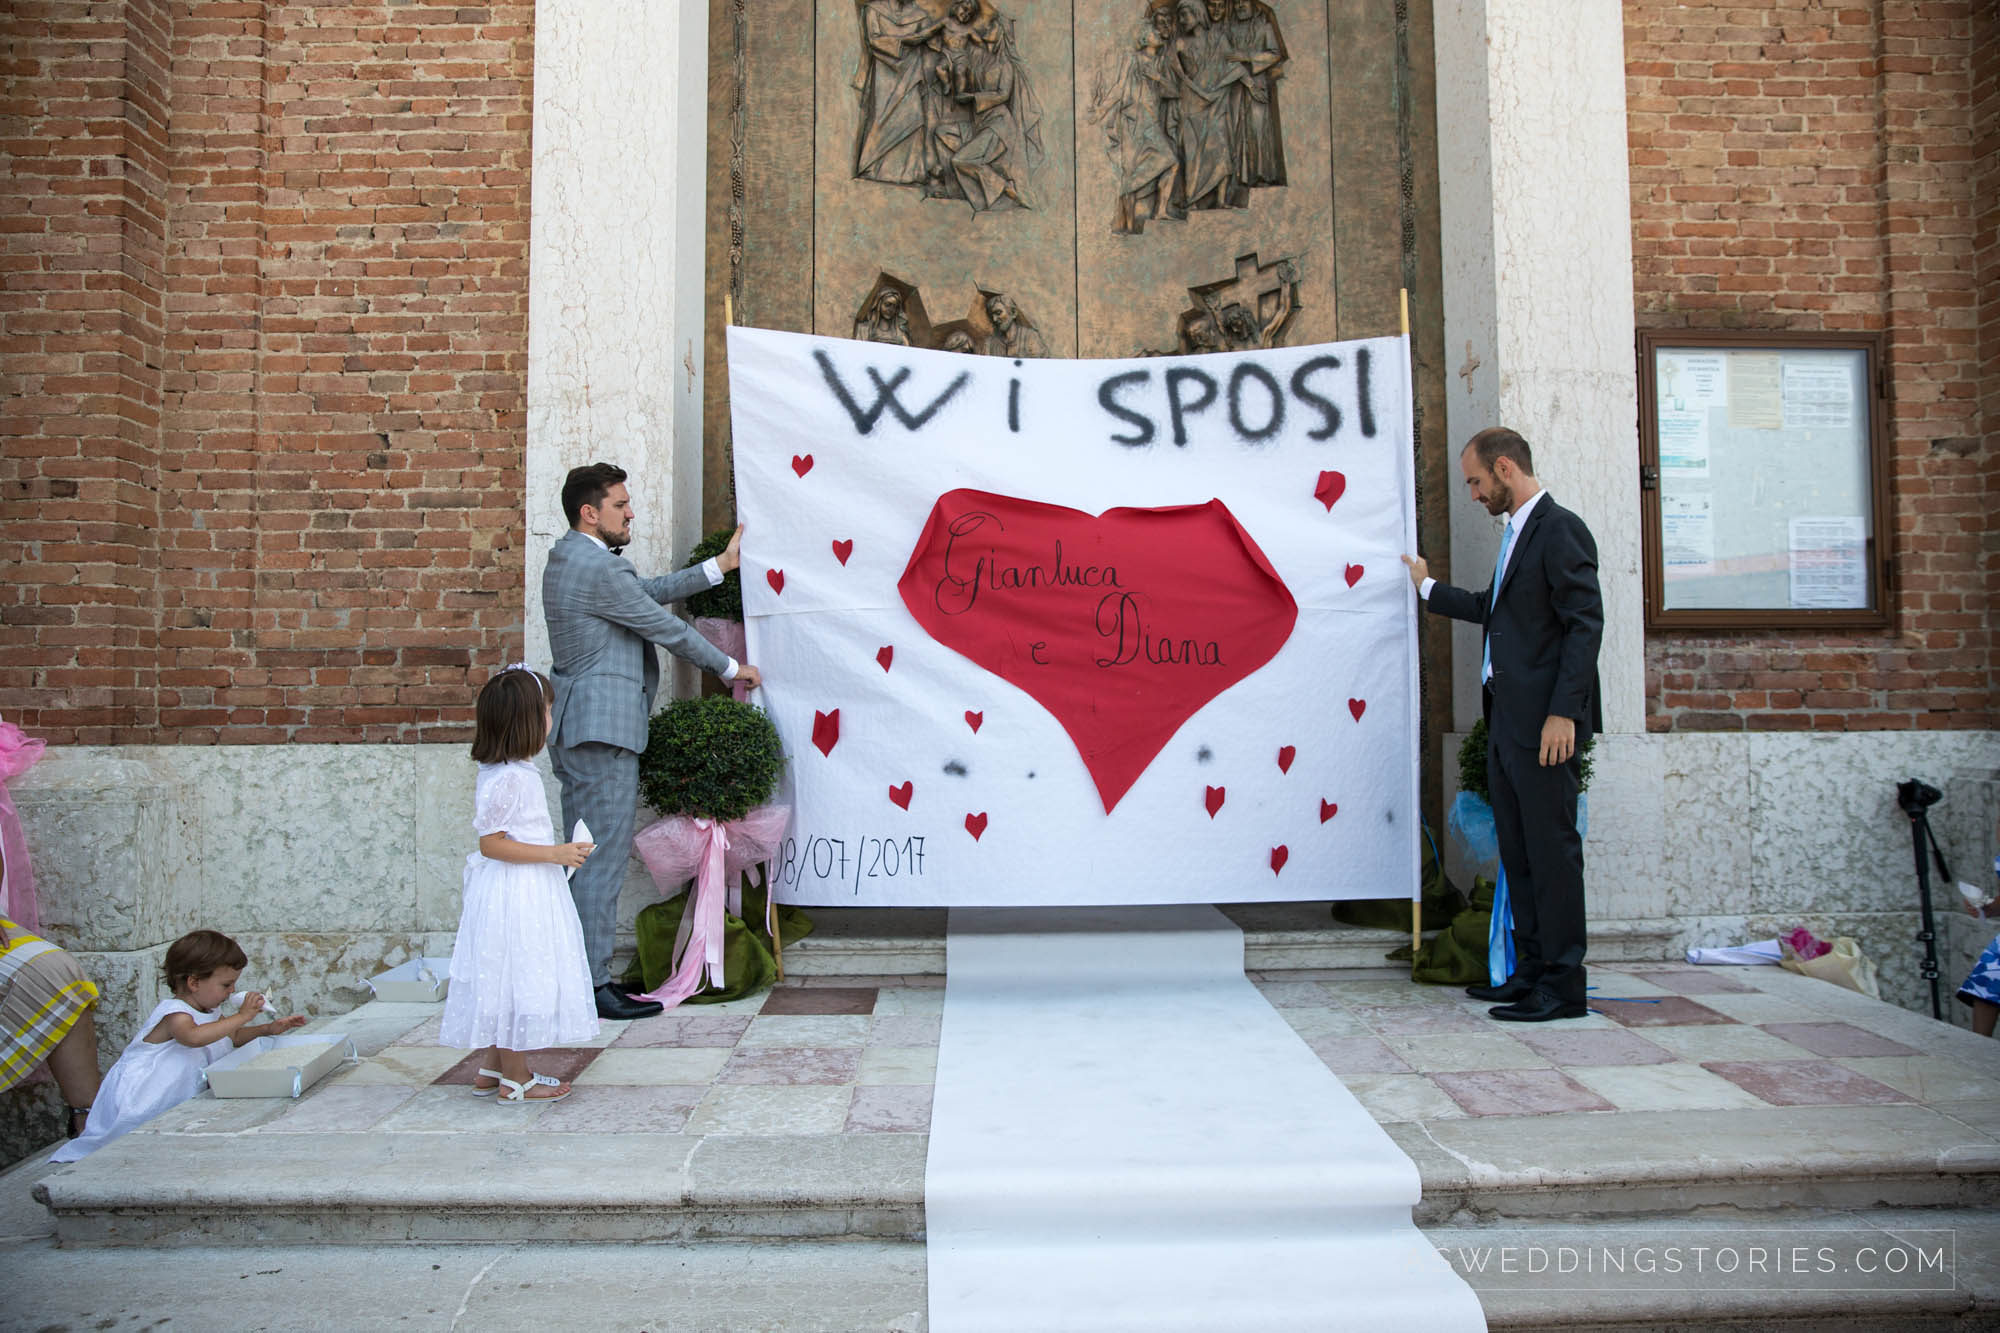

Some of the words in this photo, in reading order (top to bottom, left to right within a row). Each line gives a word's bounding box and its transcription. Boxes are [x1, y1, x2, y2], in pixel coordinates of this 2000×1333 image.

[813, 349, 972, 434] W
[1008, 359, 1023, 433] i
[1099, 348, 1376, 448] SPOSI
[935, 511, 1126, 615] Gianluca
[1030, 641, 1049, 666] e
[1095, 591, 1227, 668] Diana
[768, 834, 925, 896] 08/07/2017
